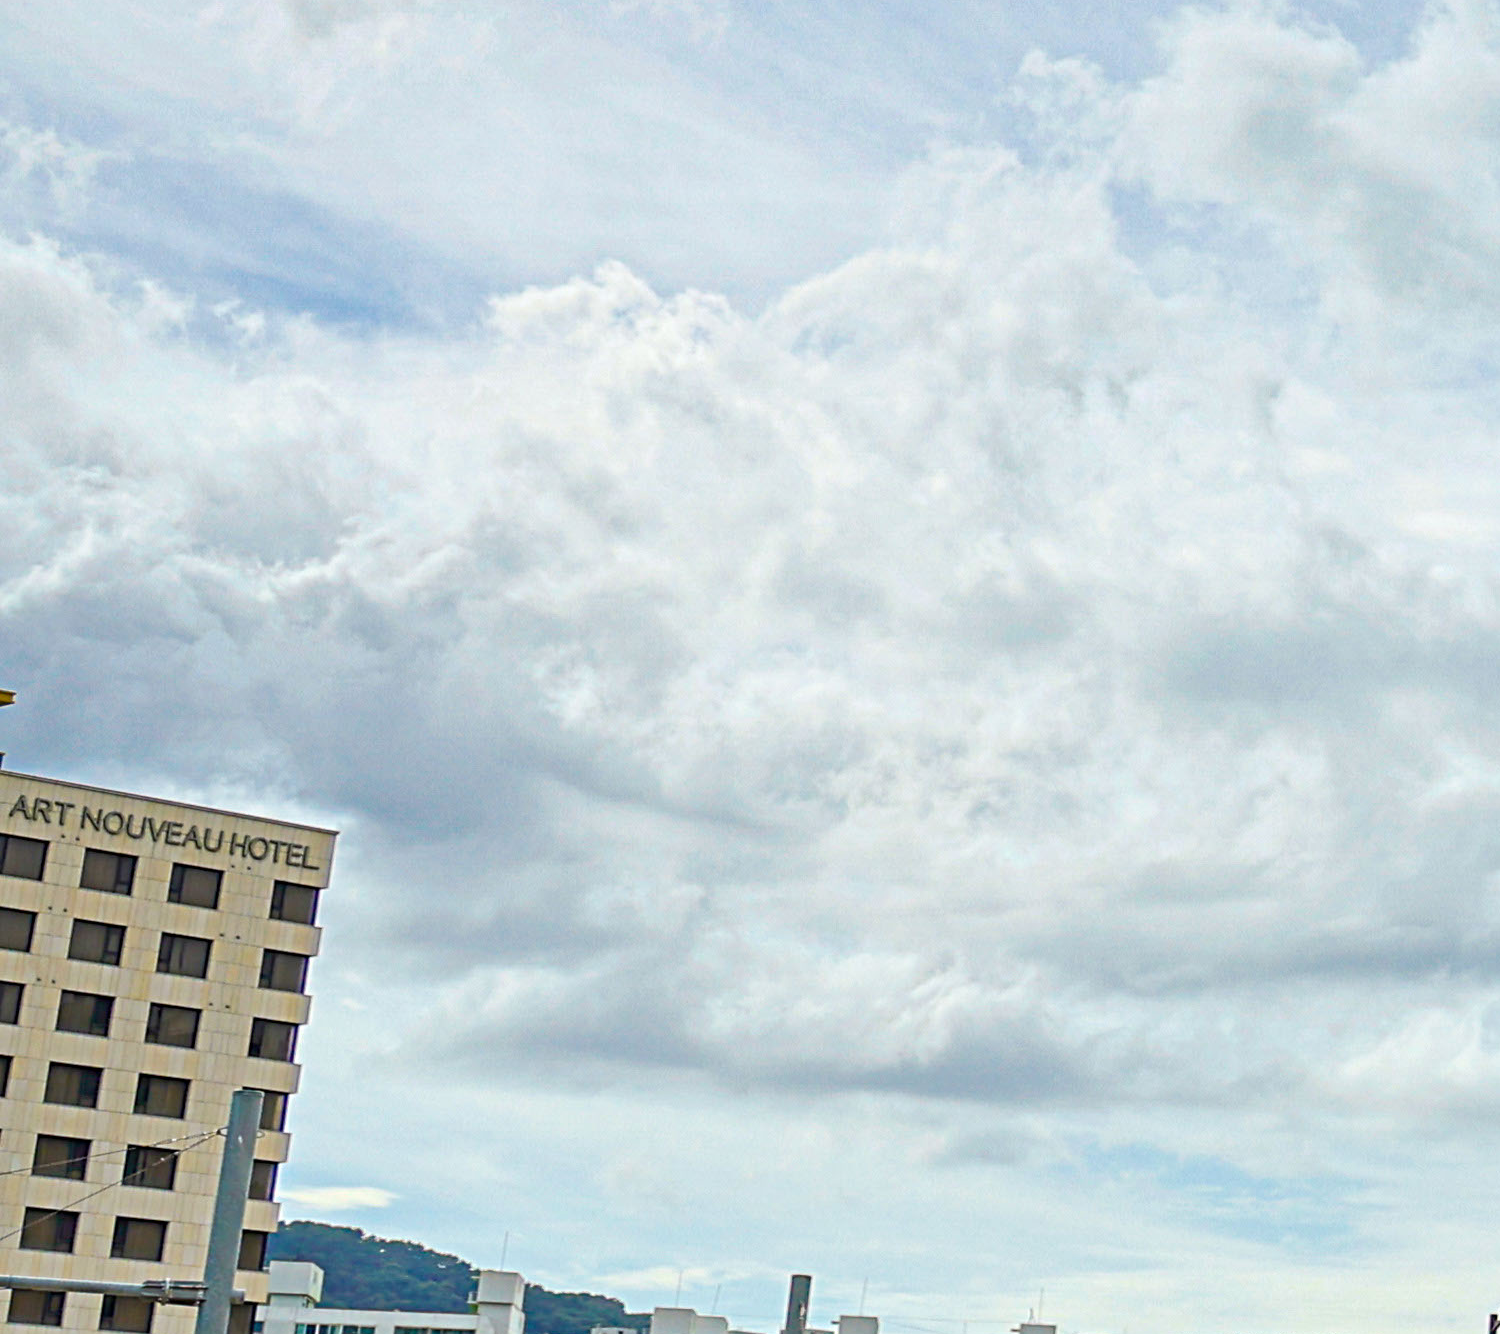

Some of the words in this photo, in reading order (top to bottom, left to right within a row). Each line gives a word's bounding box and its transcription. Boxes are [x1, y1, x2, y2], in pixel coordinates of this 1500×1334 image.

[9, 794, 75, 827] ART
[80, 806, 225, 853] NOUVEAU
[229, 832, 320, 870] HOTEL
